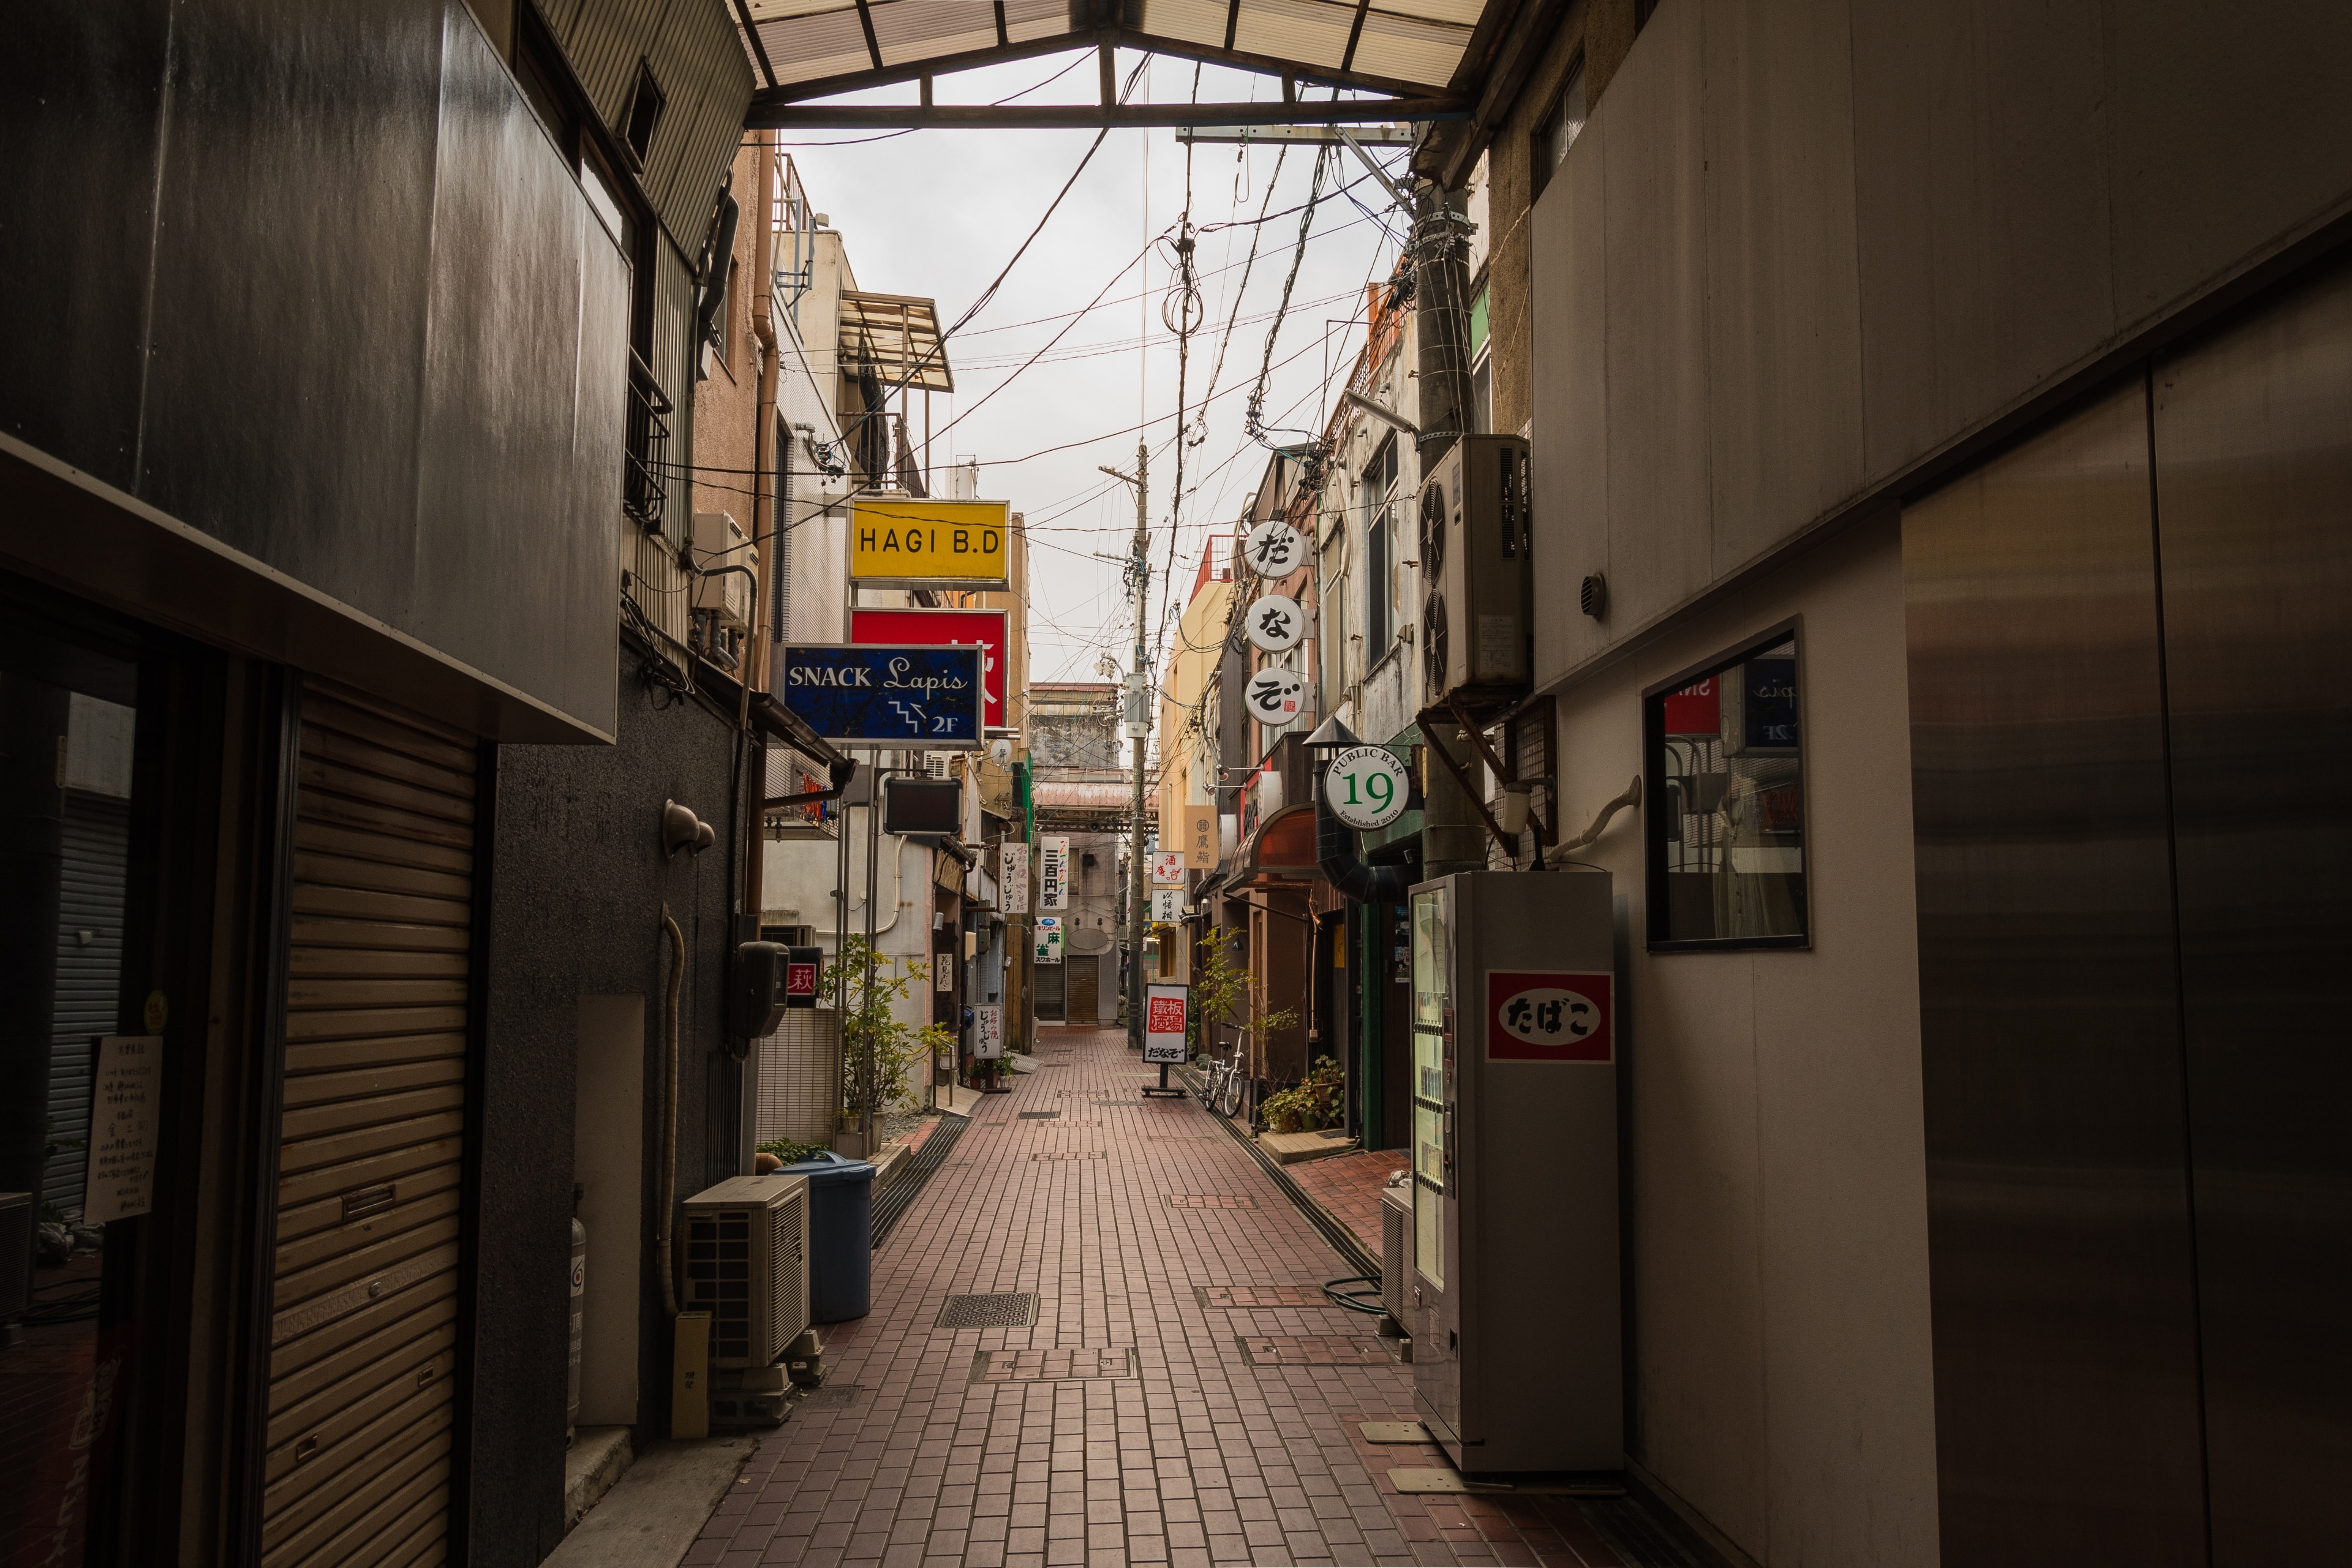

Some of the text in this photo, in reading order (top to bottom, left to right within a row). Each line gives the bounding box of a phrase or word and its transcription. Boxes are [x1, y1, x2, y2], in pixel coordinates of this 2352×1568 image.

[861, 528, 999, 554] HAGI B.D
[789, 666, 872, 687] SNACK
[883, 657, 968, 700] Lapis
[932, 716, 958, 733] 2F
[1332, 748, 1403, 778] PUBLIC BAR
[1342, 772, 1394, 815] 19
[1340, 809, 1399, 827] Established 2010
[1196, 834, 1210, 864] 鷹鮨
[1004, 852, 1016, 911] じゅうじゅう
[1044, 850, 1059, 907] 三百円家
[1036, 932, 1060, 956] 麻雀
[939, 955, 951, 990] 花見だんご
[978, 1009, 990, 1054] じゅうじゅう
[990, 1010, 999, 1040] お好み焼
[1152, 1016, 1183, 1031] 酒場
[1507, 997, 1589, 1036] たばこ
[1147, 1047, 1185, 1058] だなぞ
